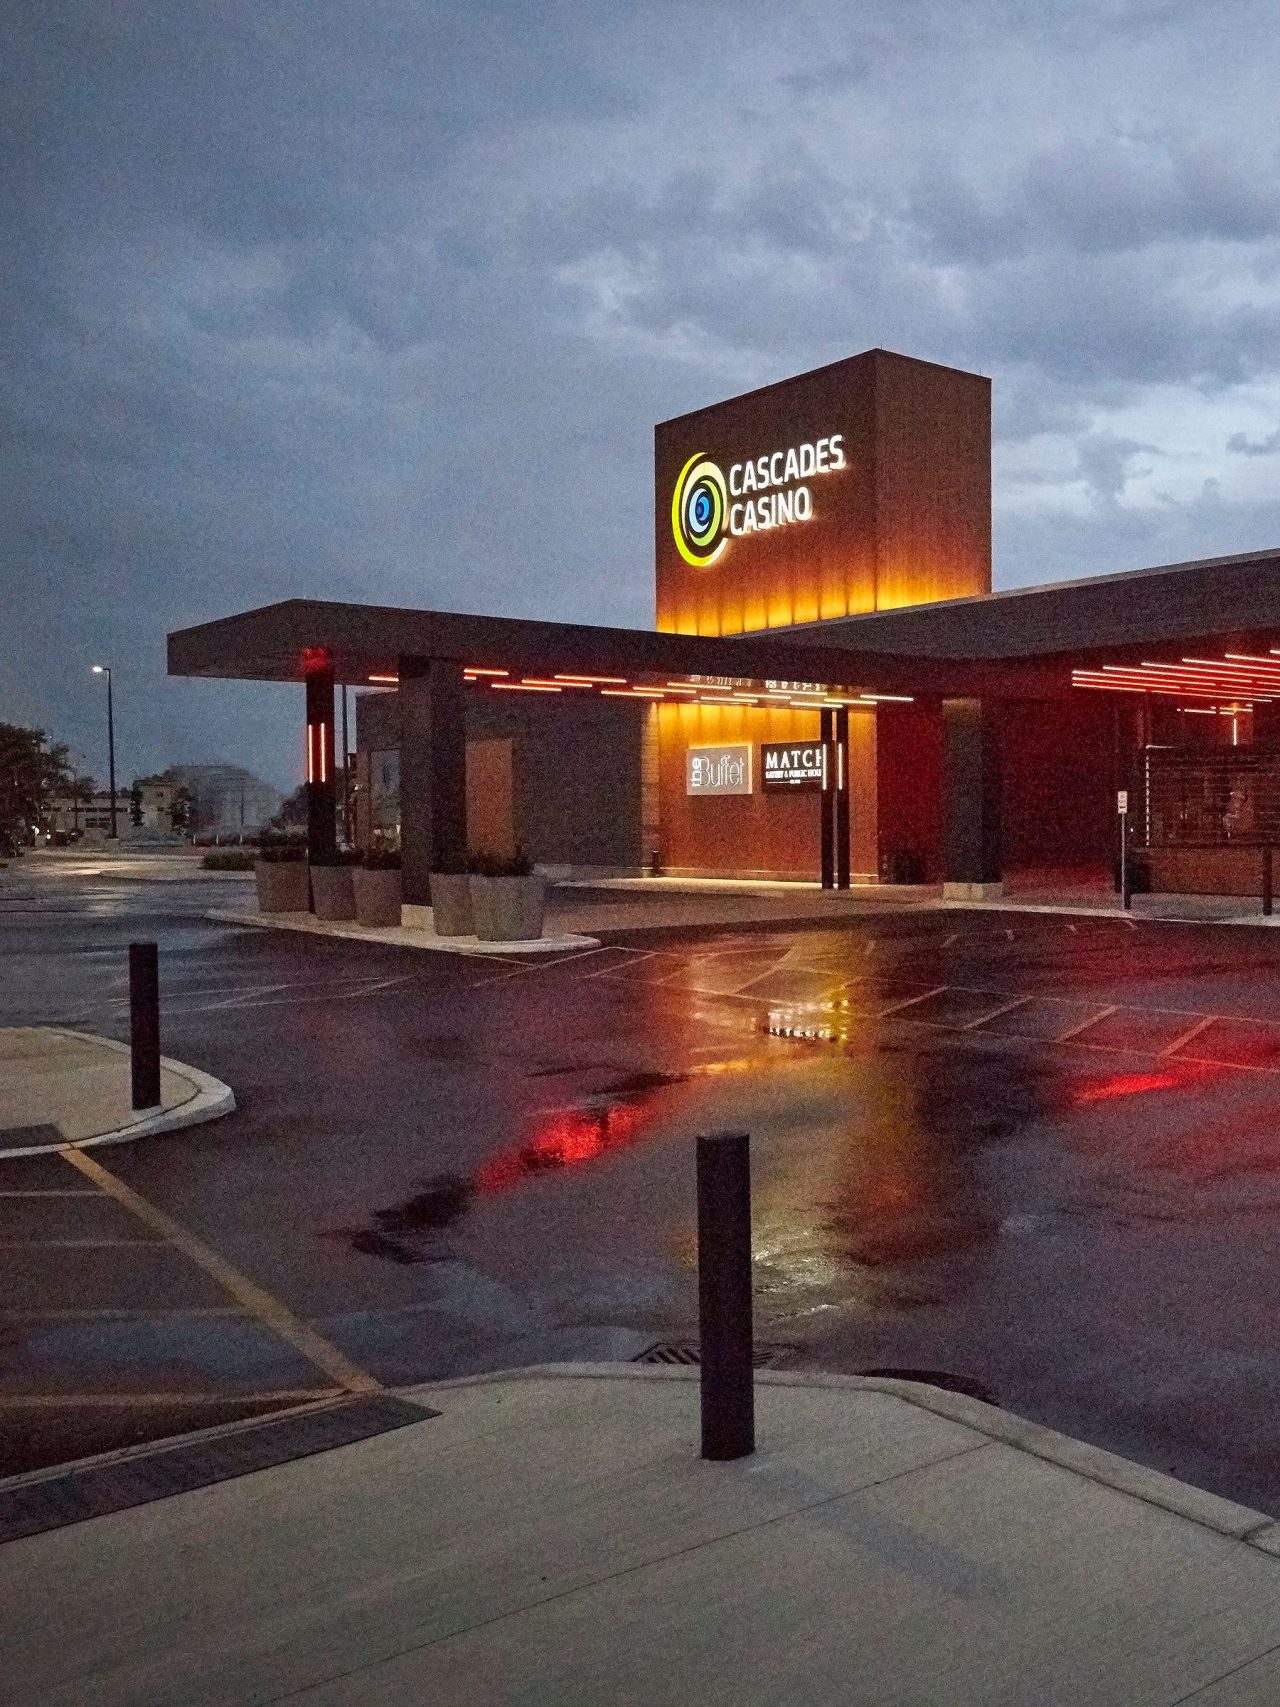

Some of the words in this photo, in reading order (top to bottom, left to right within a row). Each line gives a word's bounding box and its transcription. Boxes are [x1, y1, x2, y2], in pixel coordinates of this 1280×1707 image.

[729, 434, 847, 496] CASCADES
[729, 486, 813, 536] CASINO
[699, 755, 744, 786] Buffet
